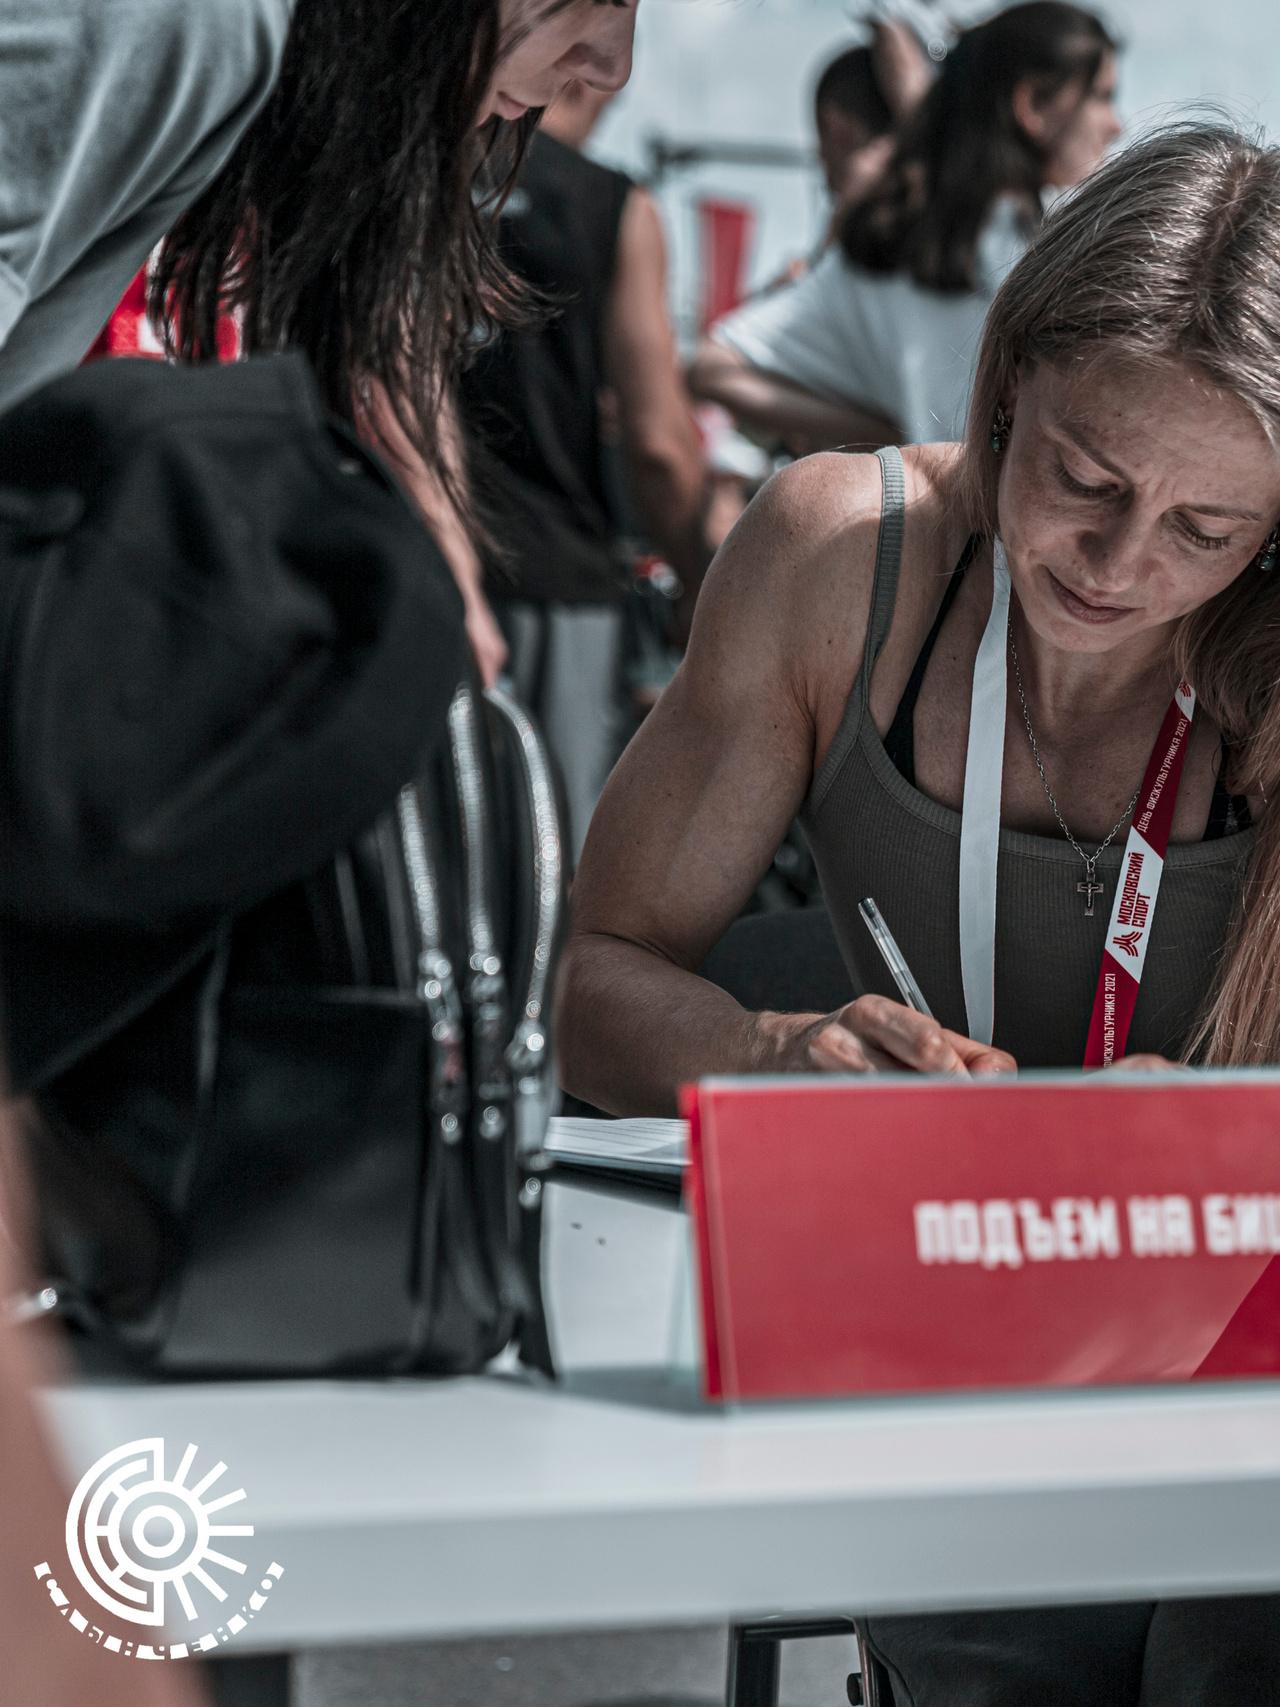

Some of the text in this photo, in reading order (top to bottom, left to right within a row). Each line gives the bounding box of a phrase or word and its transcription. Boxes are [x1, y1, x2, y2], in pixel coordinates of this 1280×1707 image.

[1137, 719, 1188, 833] ДЕНЬ ФИЗКУЛЬТУРНИКА 2021
[1117, 852, 1145, 925] МОСКОВСКИЙ
[1131, 892, 1151, 928] СПОРТ
[1104, 973, 1116, 992] 2021
[914, 1197, 1121, 1270] ПОДЪЕМ
[1127, 1193, 1196, 1259] НА
